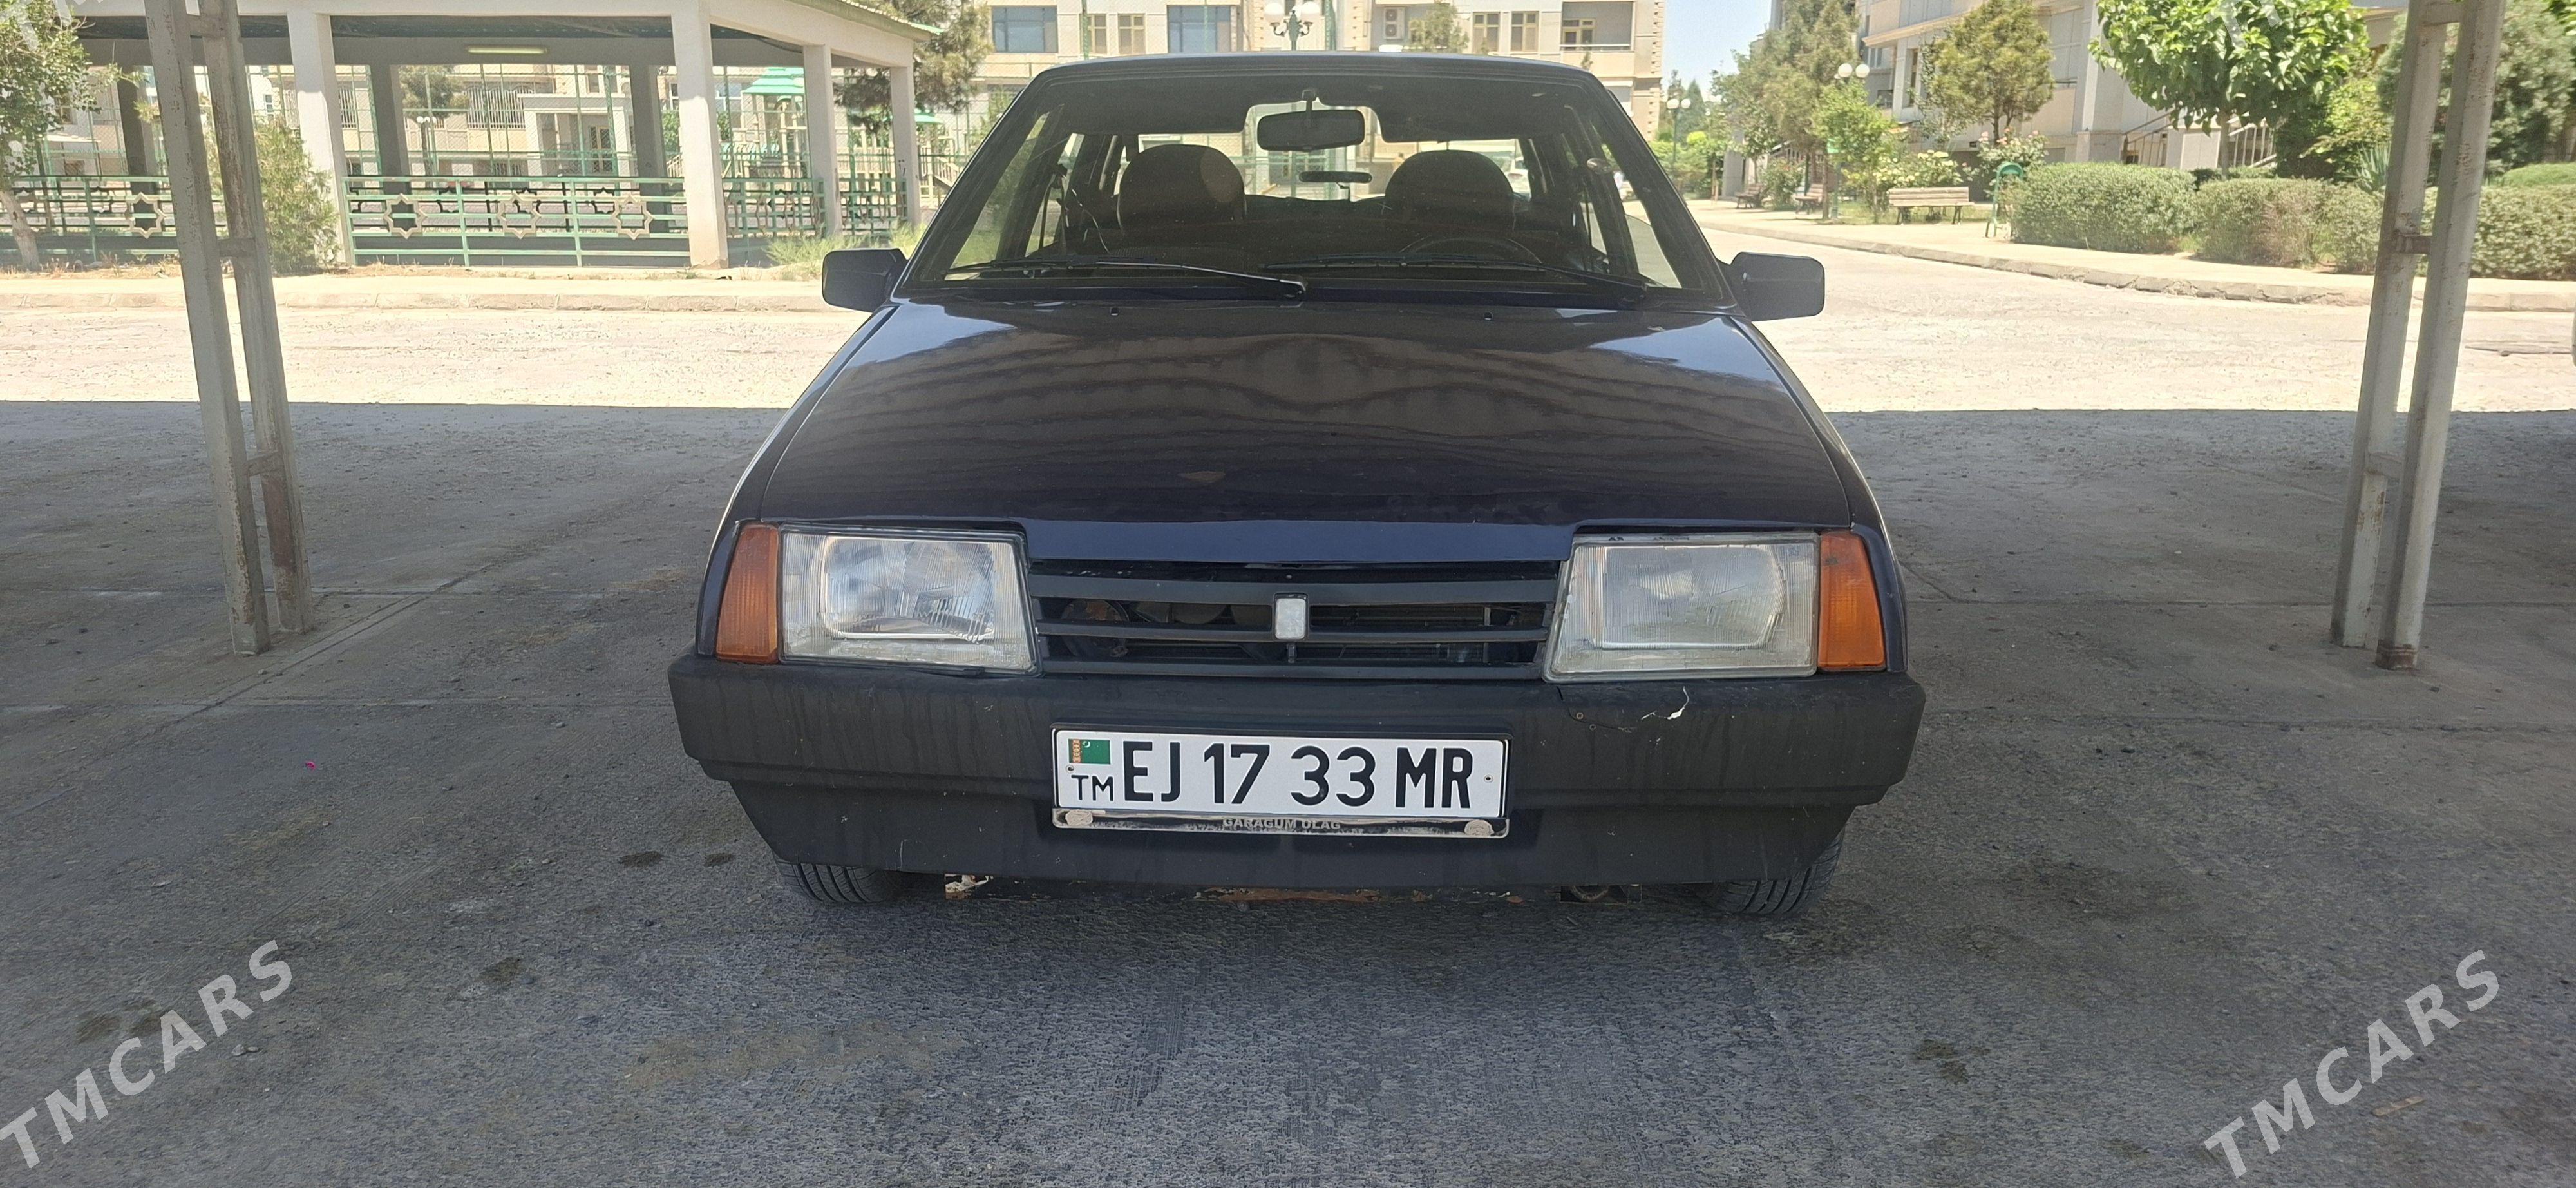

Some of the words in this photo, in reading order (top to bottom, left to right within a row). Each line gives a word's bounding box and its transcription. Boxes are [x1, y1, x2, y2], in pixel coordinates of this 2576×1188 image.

[1071, 775, 1114, 801] TM
[1123, 741, 1181, 803] EJ
[1203, 743, 1271, 805] 17
[1290, 745, 1376, 807] 33
[1396, 747, 1473, 809] MR
[1222, 818, 1296, 830] GARAGUM
[1301, 819, 1341, 830] ULAG
